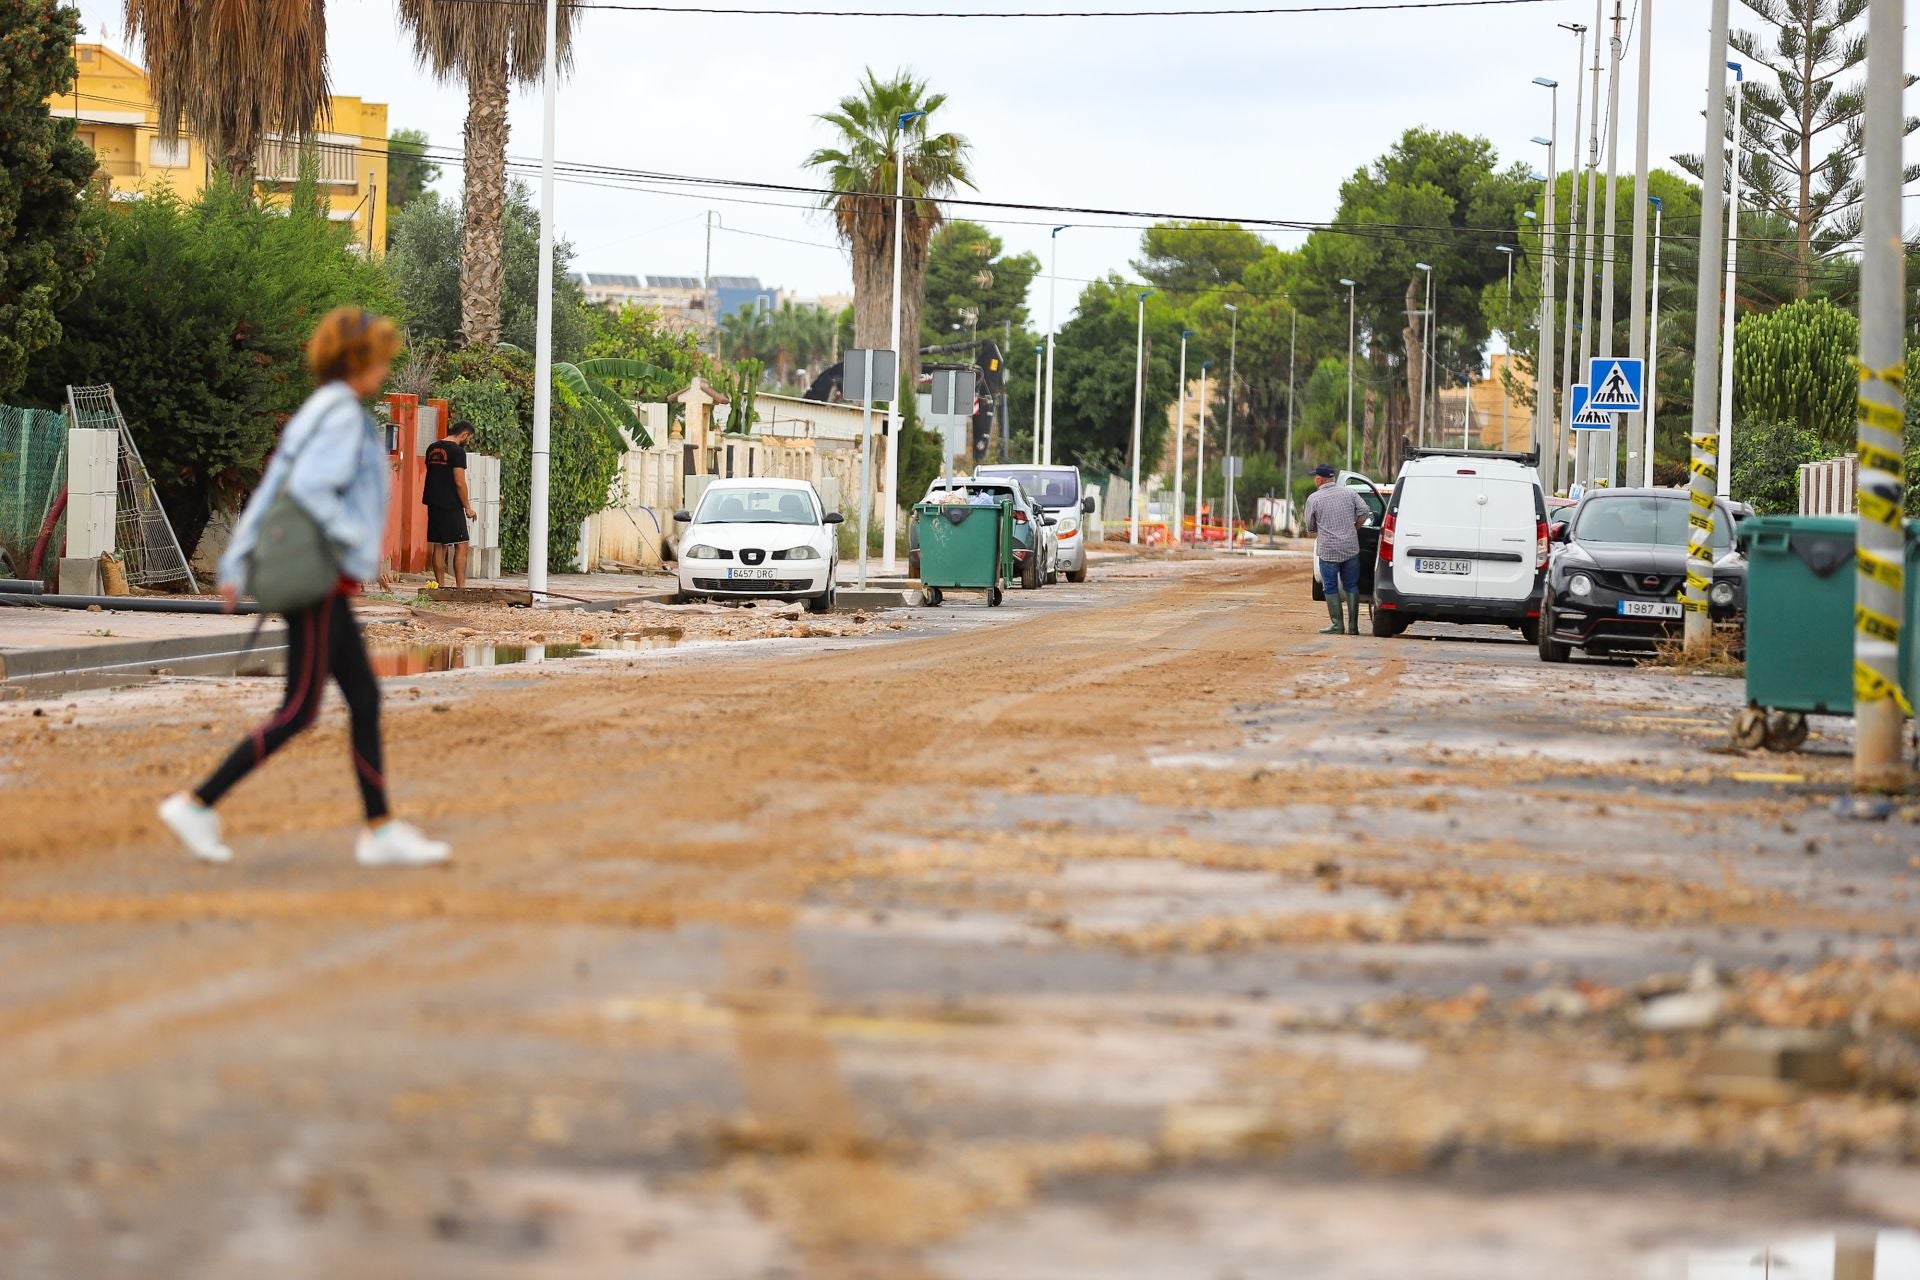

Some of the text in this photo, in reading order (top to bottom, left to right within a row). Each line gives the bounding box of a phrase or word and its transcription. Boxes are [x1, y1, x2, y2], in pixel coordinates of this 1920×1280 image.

[1422, 560, 1468, 572] 9882 LKH
[733, 569, 753, 578] 6457
[1628, 603, 1654, 614] 1987
[1658, 605, 1679, 616] JWN
